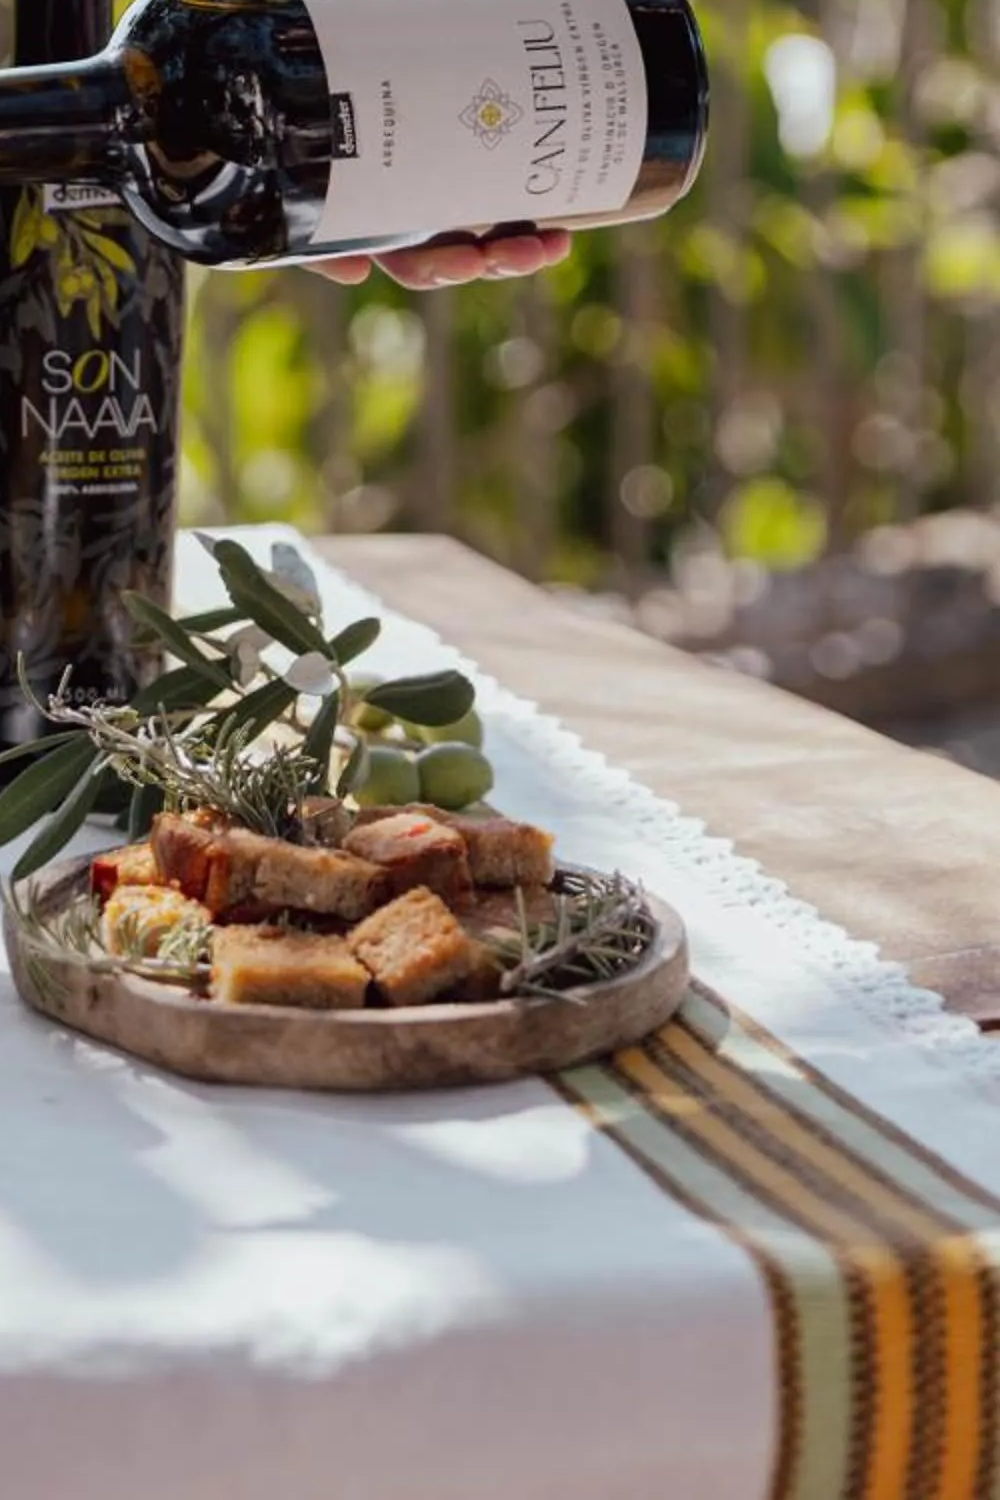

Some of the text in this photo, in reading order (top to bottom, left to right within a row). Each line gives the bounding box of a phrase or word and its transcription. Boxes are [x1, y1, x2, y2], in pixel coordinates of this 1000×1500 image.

[381, 80, 395, 166] ARBEQUINA
[41, 349, 141, 393] SON
[20, 394, 158, 439] NAAVA
